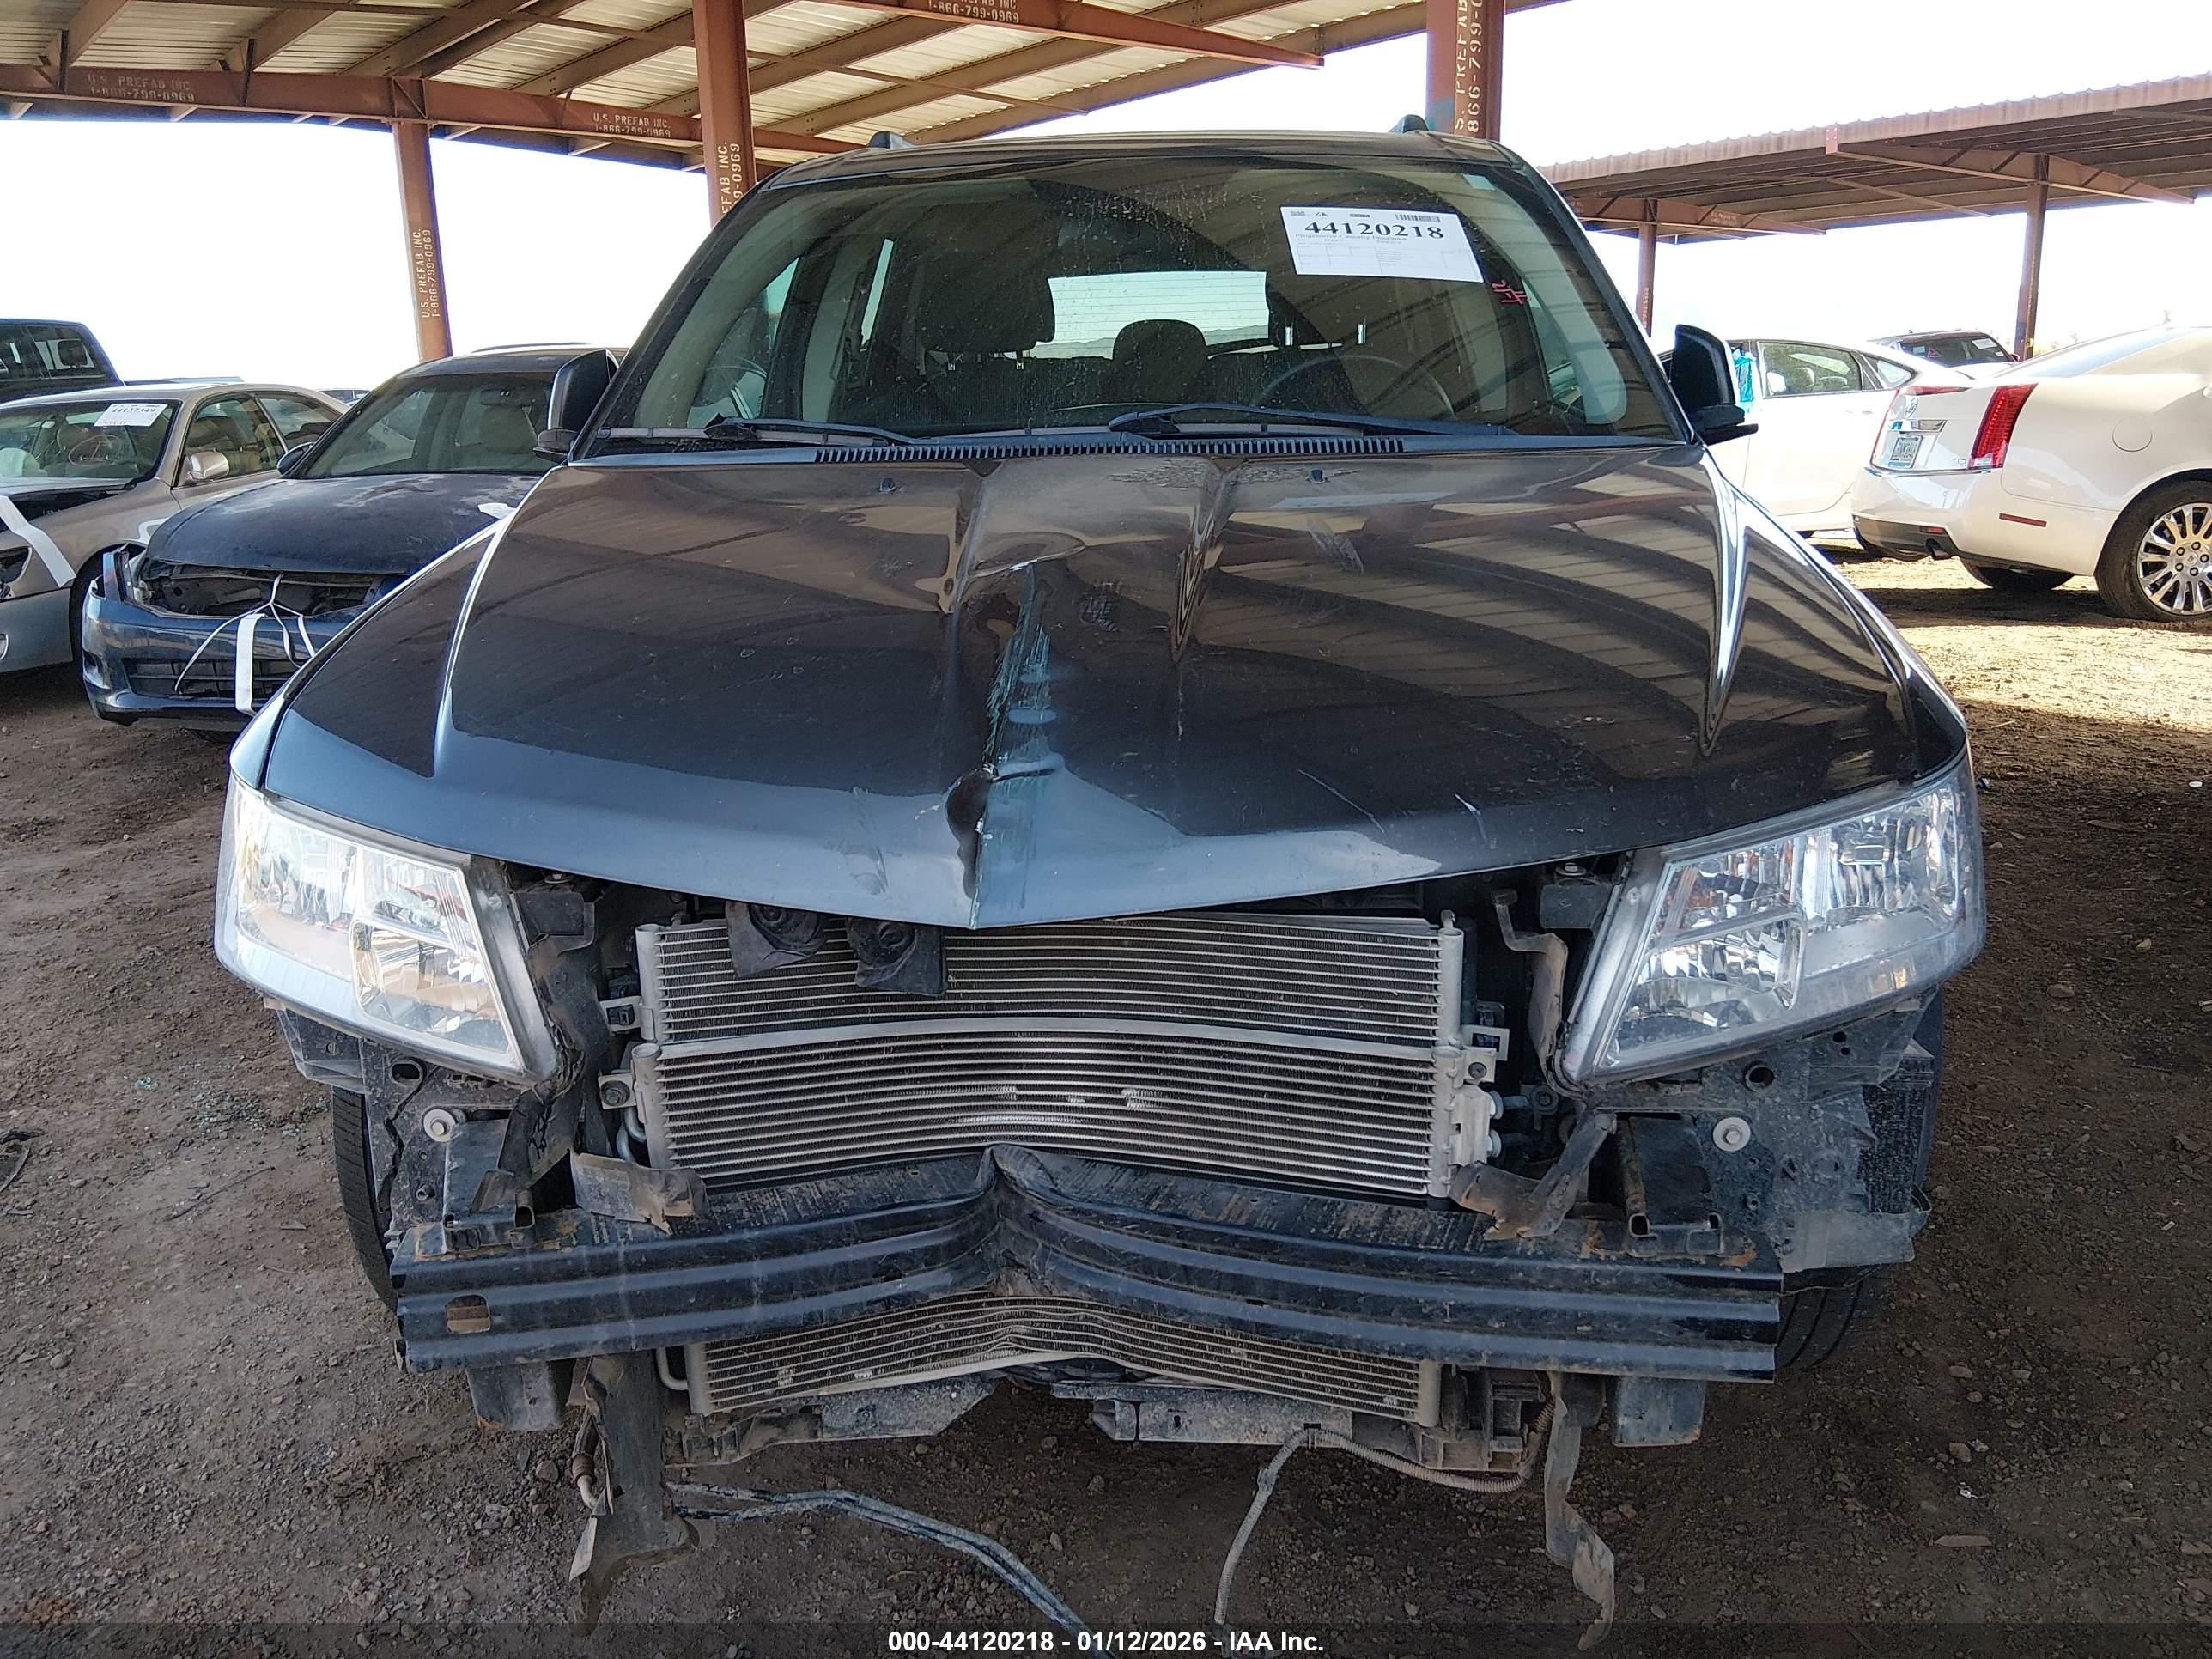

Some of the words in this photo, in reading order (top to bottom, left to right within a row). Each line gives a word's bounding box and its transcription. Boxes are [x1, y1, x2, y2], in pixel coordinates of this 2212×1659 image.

[928, 0, 1020, 24] 1-866-799-0969
[592, 112, 611, 124] U.S.
[614, 114, 650, 127] PREFAB
[653, 118, 672, 129] INC.
[594, 124, 672, 137] 1-866-799-0969
[717, 141, 729, 168] INC.
[720, 176, 732, 215] EFAB
[412, 228, 422, 248] INC.
[1304, 222, 1444, 240] 44120218
[415, 253, 428, 293] PREFAB
[422, 229, 441, 317] 1-866-799-0969
[421, 298, 430, 318] U.S.
